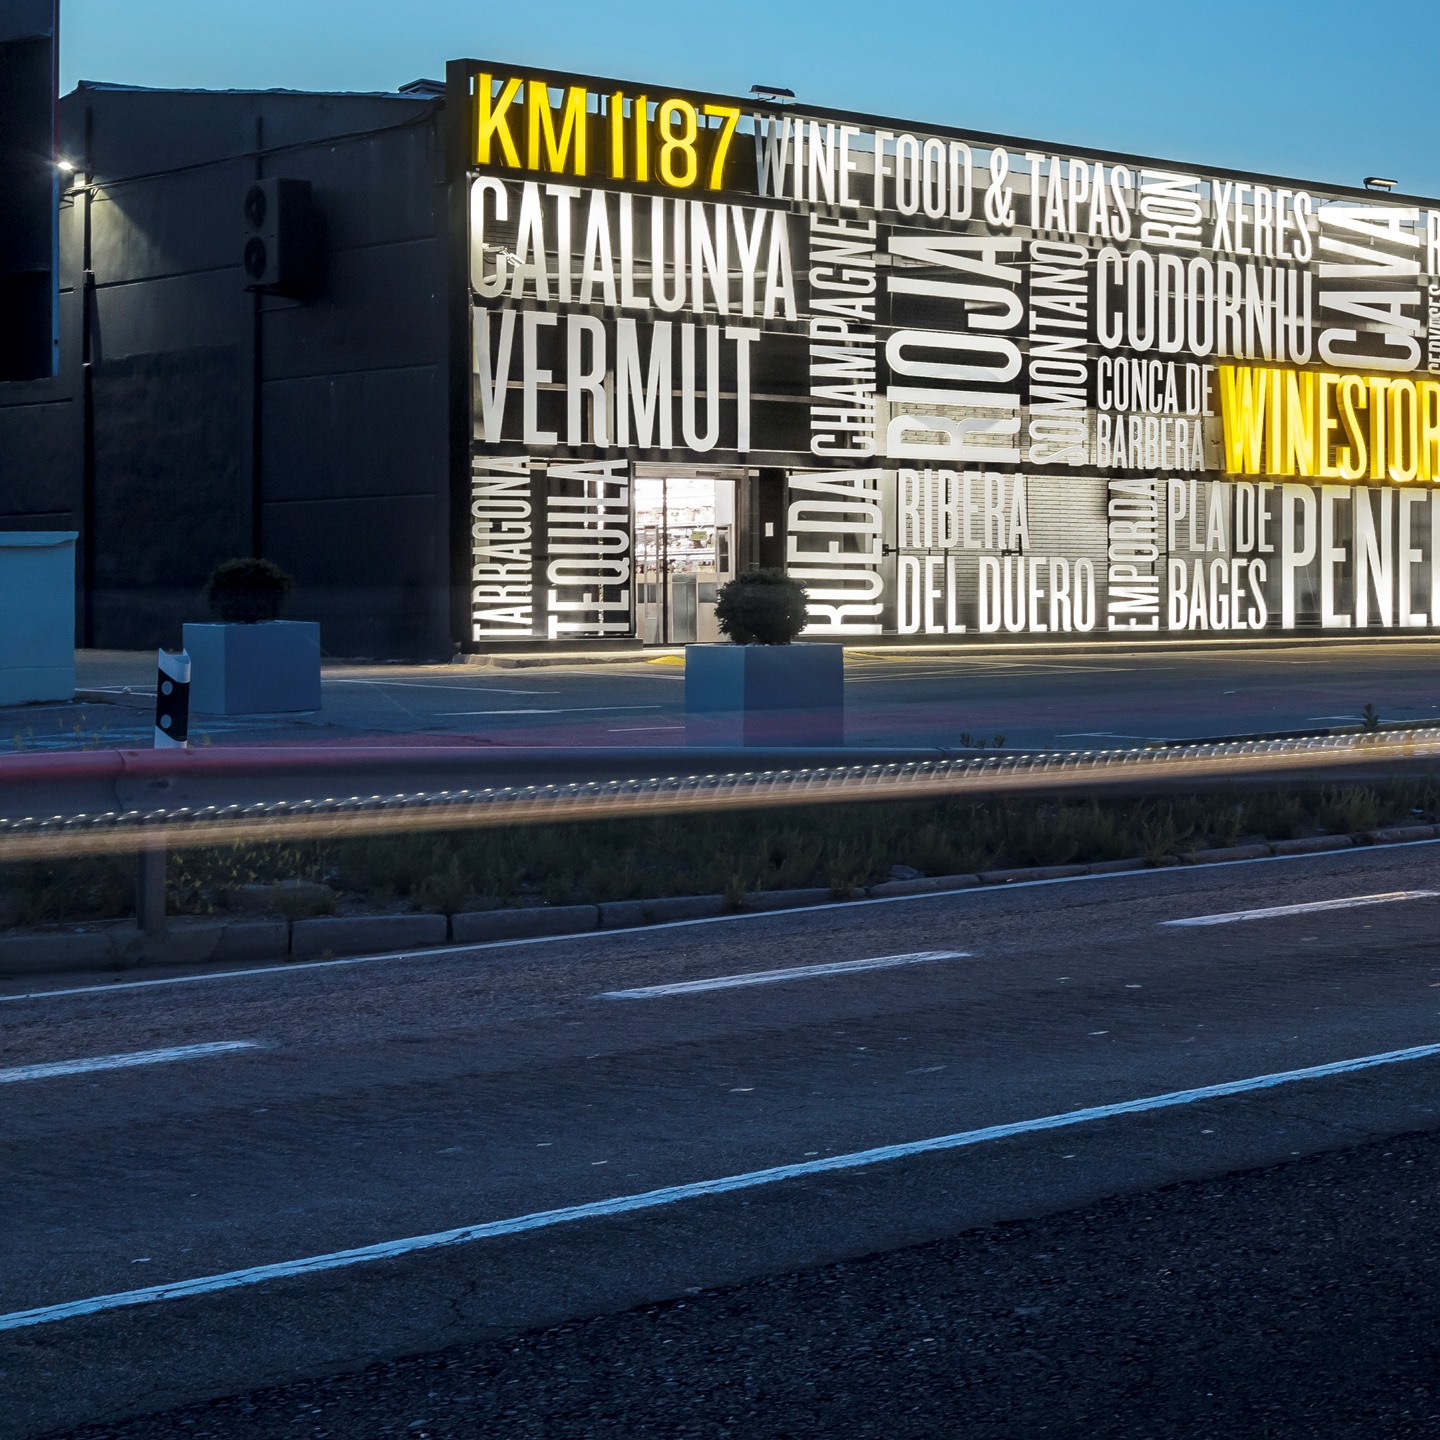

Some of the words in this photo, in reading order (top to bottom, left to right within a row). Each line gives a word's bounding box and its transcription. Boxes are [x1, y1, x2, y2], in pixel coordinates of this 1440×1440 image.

[474, 73, 587, 176] KM
[608, 91, 741, 191] 1187
[753, 112, 860, 208] WINE
[874, 130, 972, 220] FOOD
[984, 147, 1015, 227] &
[1025, 152, 1132, 242] TAPAS
[470, 177, 798, 321] CATALUNYA
[1140, 169, 1202, 249] RON
[1212, 179, 1312, 263] XERES
[808, 212, 876, 458] CHAMPAGNE
[886, 236, 1023, 464] RIOJA
[1029, 240, 1089, 467] SOMONTANO
[1096, 247, 1312, 365] CODORNIU
[1318, 207, 1421, 372] CAVA
[473, 307, 760, 452] VERMUT
[1097, 356, 1178, 414] CONCA
[1186, 363, 1215, 417] DE
[1097, 414, 1206, 472] BARBERA
[471, 455, 533, 642] TARRAGONA
[547, 459, 630, 639] TEQUILA
[787, 468, 884, 635] RUEDA
[898, 468, 1030, 550] RIBERA
[1108, 477, 1160, 632] EMPORDA
[1168, 478, 1226, 552] PLA
[1236, 481, 1274, 553] DE
[898, 555, 966, 634] DEL
[979, 556, 1096, 633] DUERO
[1168, 558, 1268, 630] BAGES
